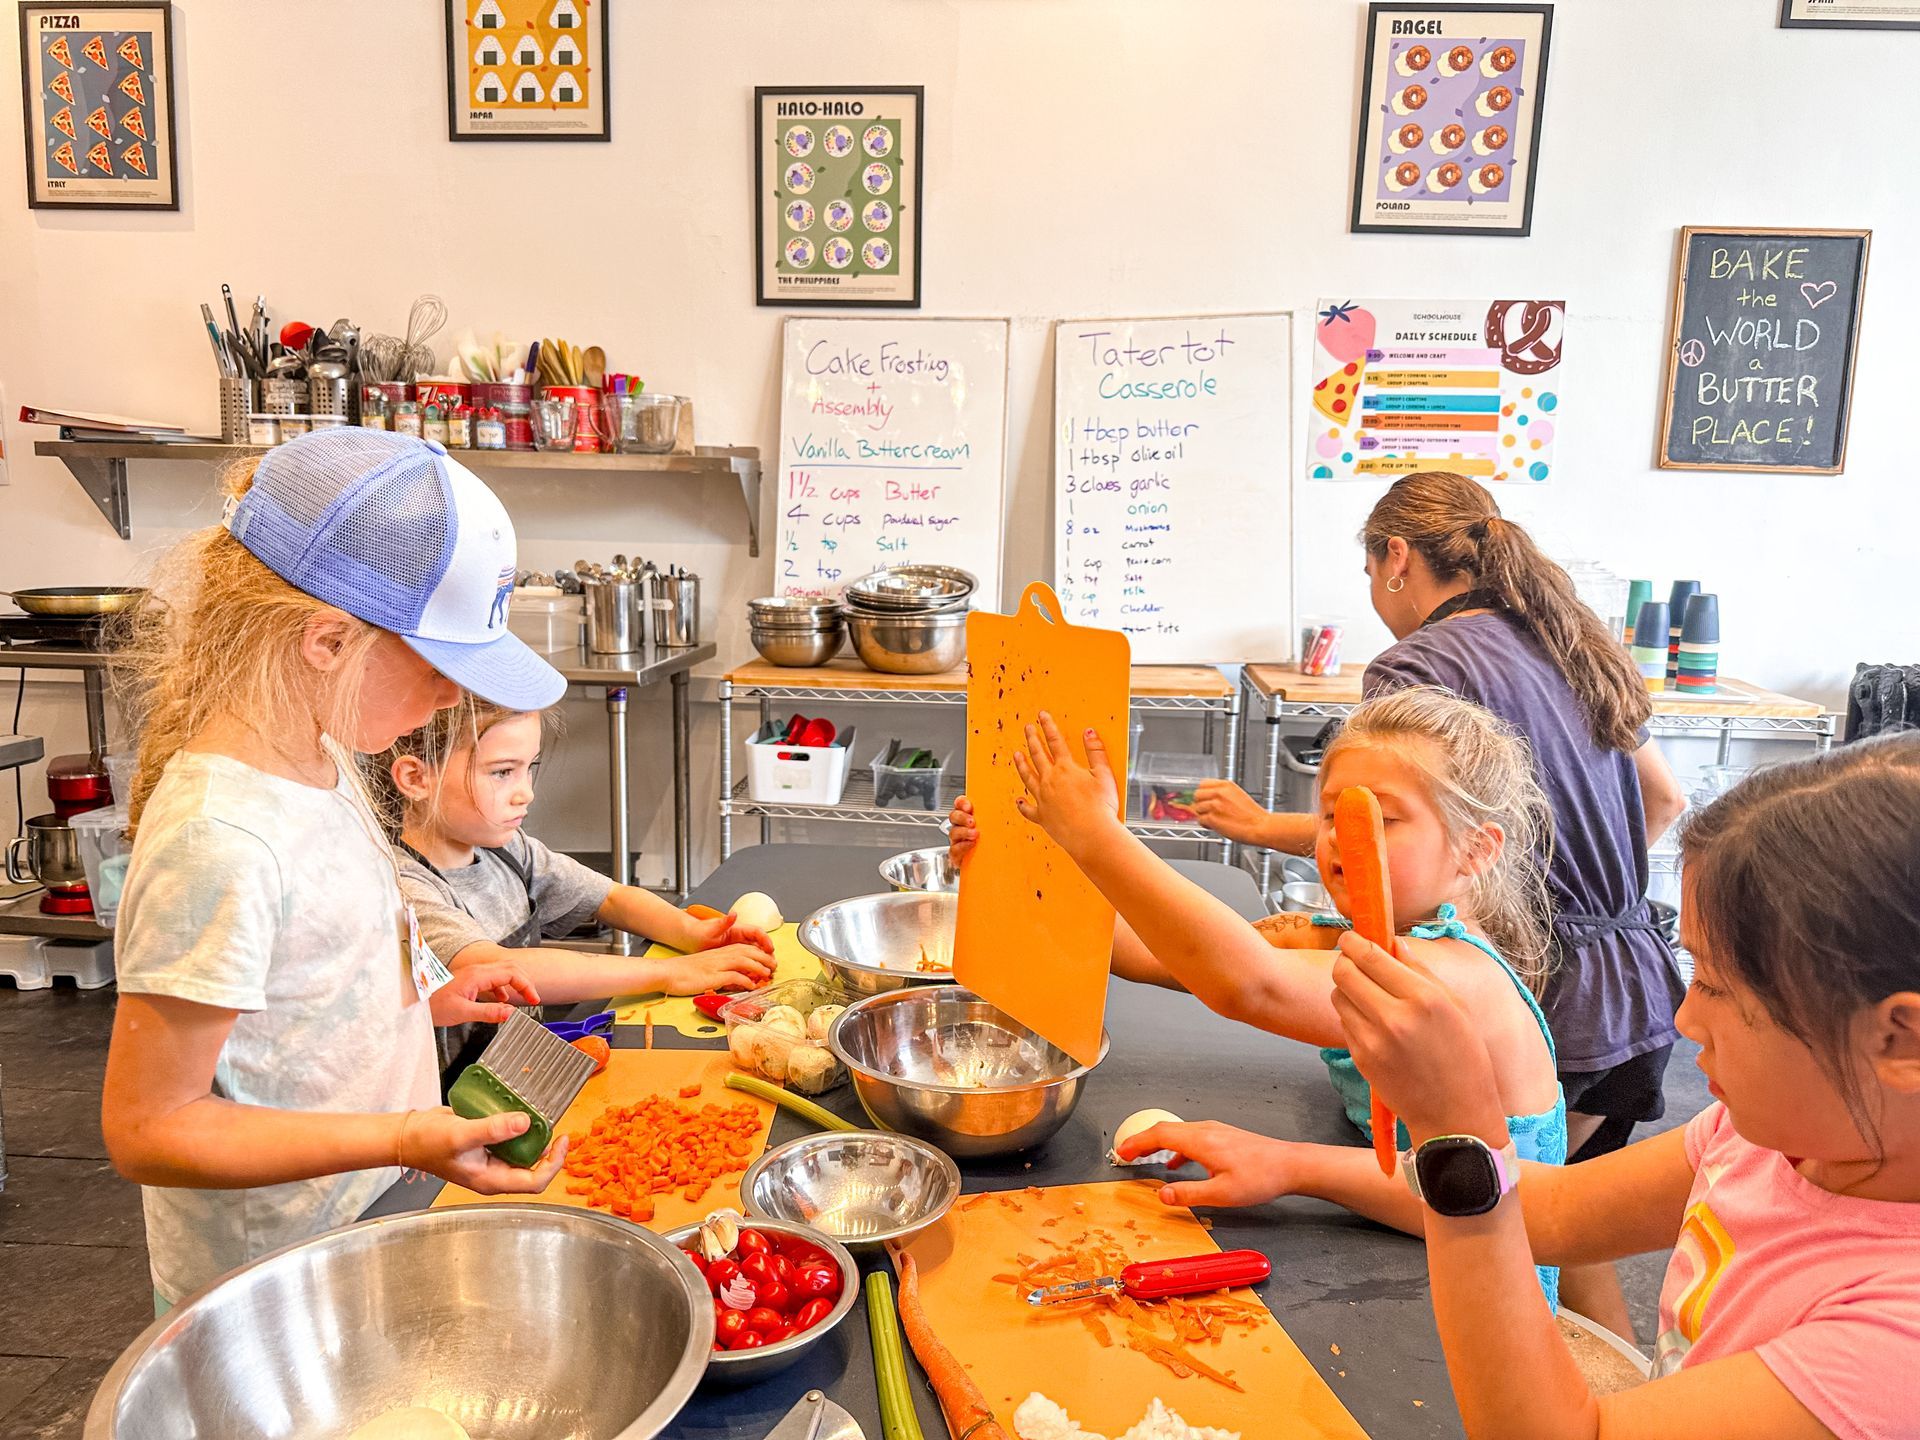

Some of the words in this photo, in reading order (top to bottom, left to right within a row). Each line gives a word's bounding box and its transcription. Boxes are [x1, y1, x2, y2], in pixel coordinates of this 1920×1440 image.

[40, 15, 80, 29] PIZZA
[1391, 20, 1442, 35] BAGEL
[777, 102, 864, 116] HALO-HALO
[1376, 202, 1410, 210] POLAND
[1709, 248, 1809, 281] BAKE
[778, 277, 792, 285] THE
[794, 277, 840, 285] PHILIPPINES
[1736, 288, 1777, 308] the
[1395, 332, 1426, 341] DAILY
[1428, 333, 1478, 341] SCHEDULE
[1705, 315, 1820, 351] WORLD
[805, 340, 874, 376] Cake
[880, 341, 950, 381] Frosting
[1749, 358, 1763, 370] a
[867, 382, 881, 394] +
[1099, 370, 1218, 400] Casserole
[1698, 372, 1819, 407] BUTTER
[811, 396, 894, 431] Assembly
[1084, 416, 1129, 454] tbsp
[1137, 418, 1200, 440] butter
[1691, 415, 1815, 446] PLACE!
[792, 433, 851, 460] Vanilla
[856, 439, 970, 460] Buttercream
[1080, 449, 1121, 473] tbsp
[1165, 442, 1183, 461] oil
[830, 487, 861, 505] cups
[885, 481, 941, 501] Butter
[1065, 475, 1076, 494] 3
[1130, 471, 1171, 499] garlic
[787, 503, 809, 525] 4
[822, 513, 861, 533] cups
[1127, 500, 1168, 515] onion
[1066, 519, 1074, 535] 8
[820, 533, 839, 555] tsp
[876, 536, 909, 552] Salt
[784, 559, 800, 578] 2
[817, 559, 842, 583] tsp
